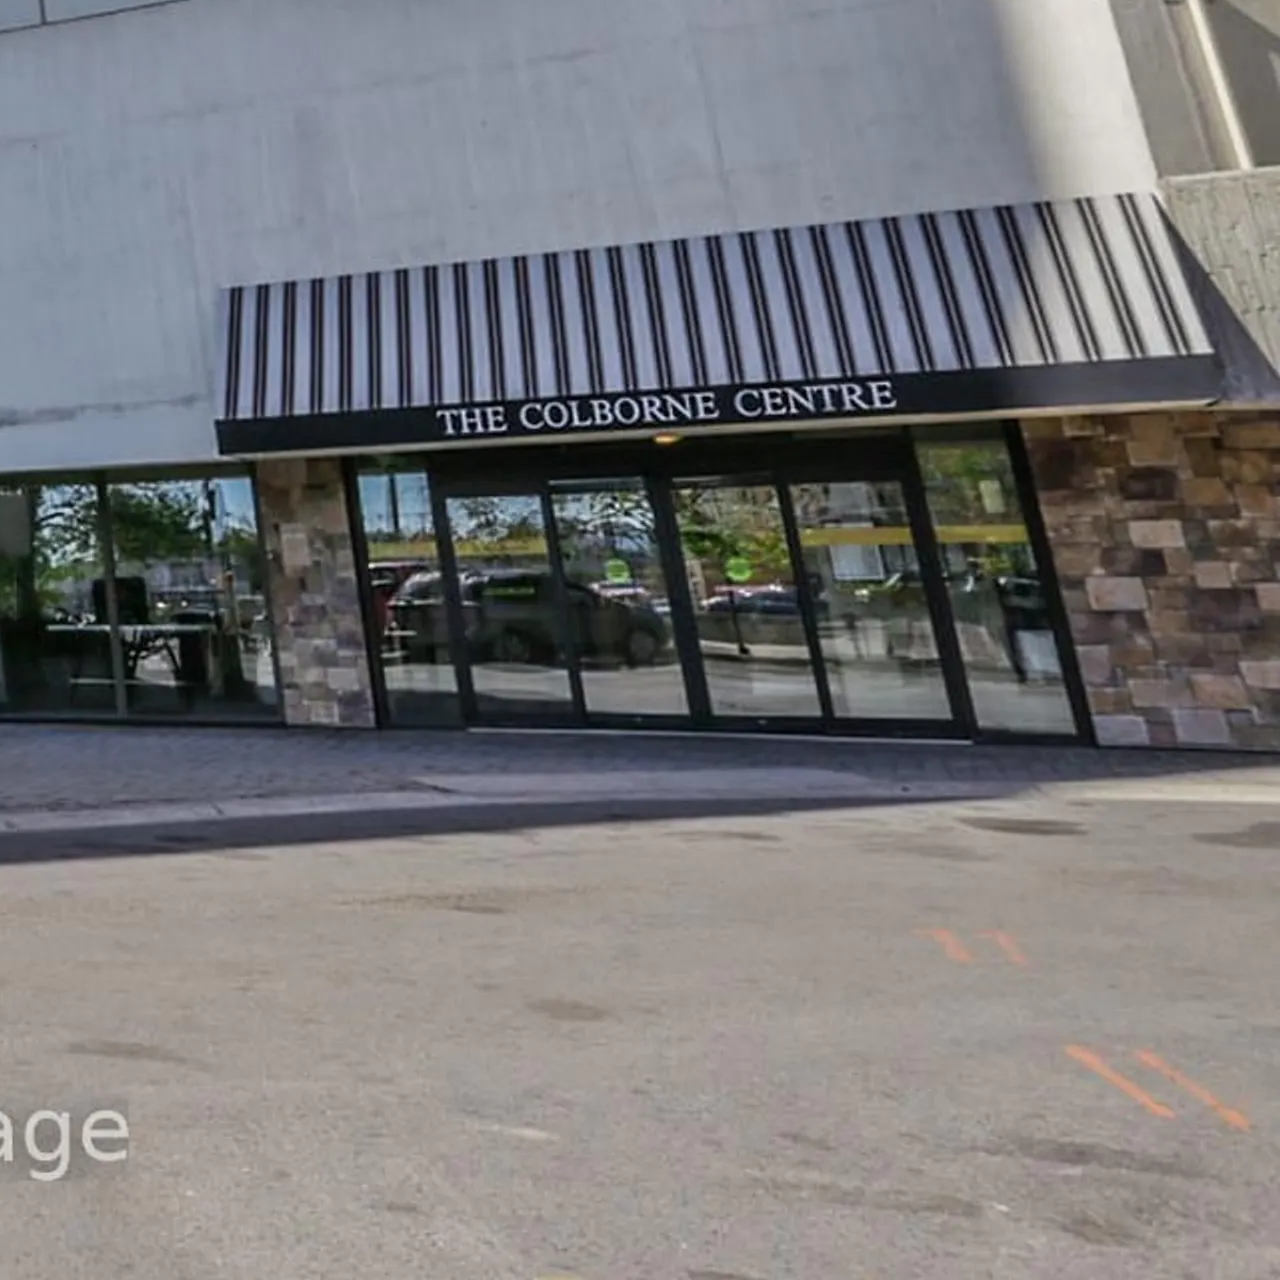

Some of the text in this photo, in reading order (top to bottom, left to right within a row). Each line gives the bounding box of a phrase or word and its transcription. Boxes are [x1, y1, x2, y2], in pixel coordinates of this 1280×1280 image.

[436, 380, 897, 436] THE COLBORNE CENTRE
